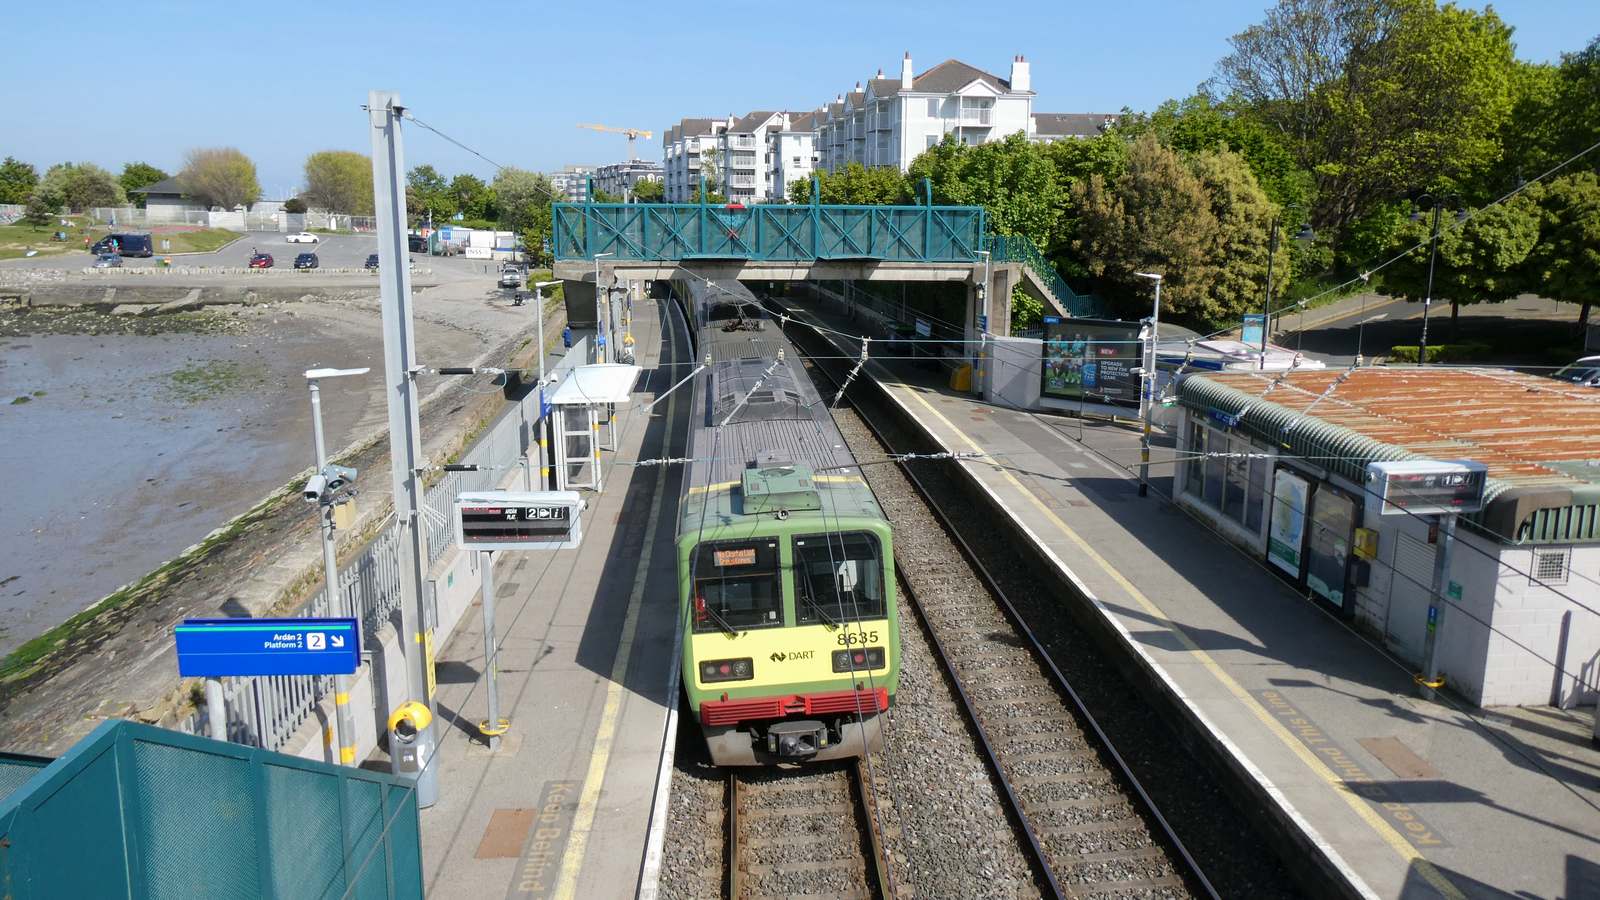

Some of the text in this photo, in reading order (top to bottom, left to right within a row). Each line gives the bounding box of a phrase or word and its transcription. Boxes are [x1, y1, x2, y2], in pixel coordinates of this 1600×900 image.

[528, 508, 537, 518] 2
[296, 633, 303, 641] 2
[312, 635, 321, 647] 2
[837, 631, 879, 645] 8635
[264, 641, 304, 649] Platform 2
[789, 650, 815, 660] DART
